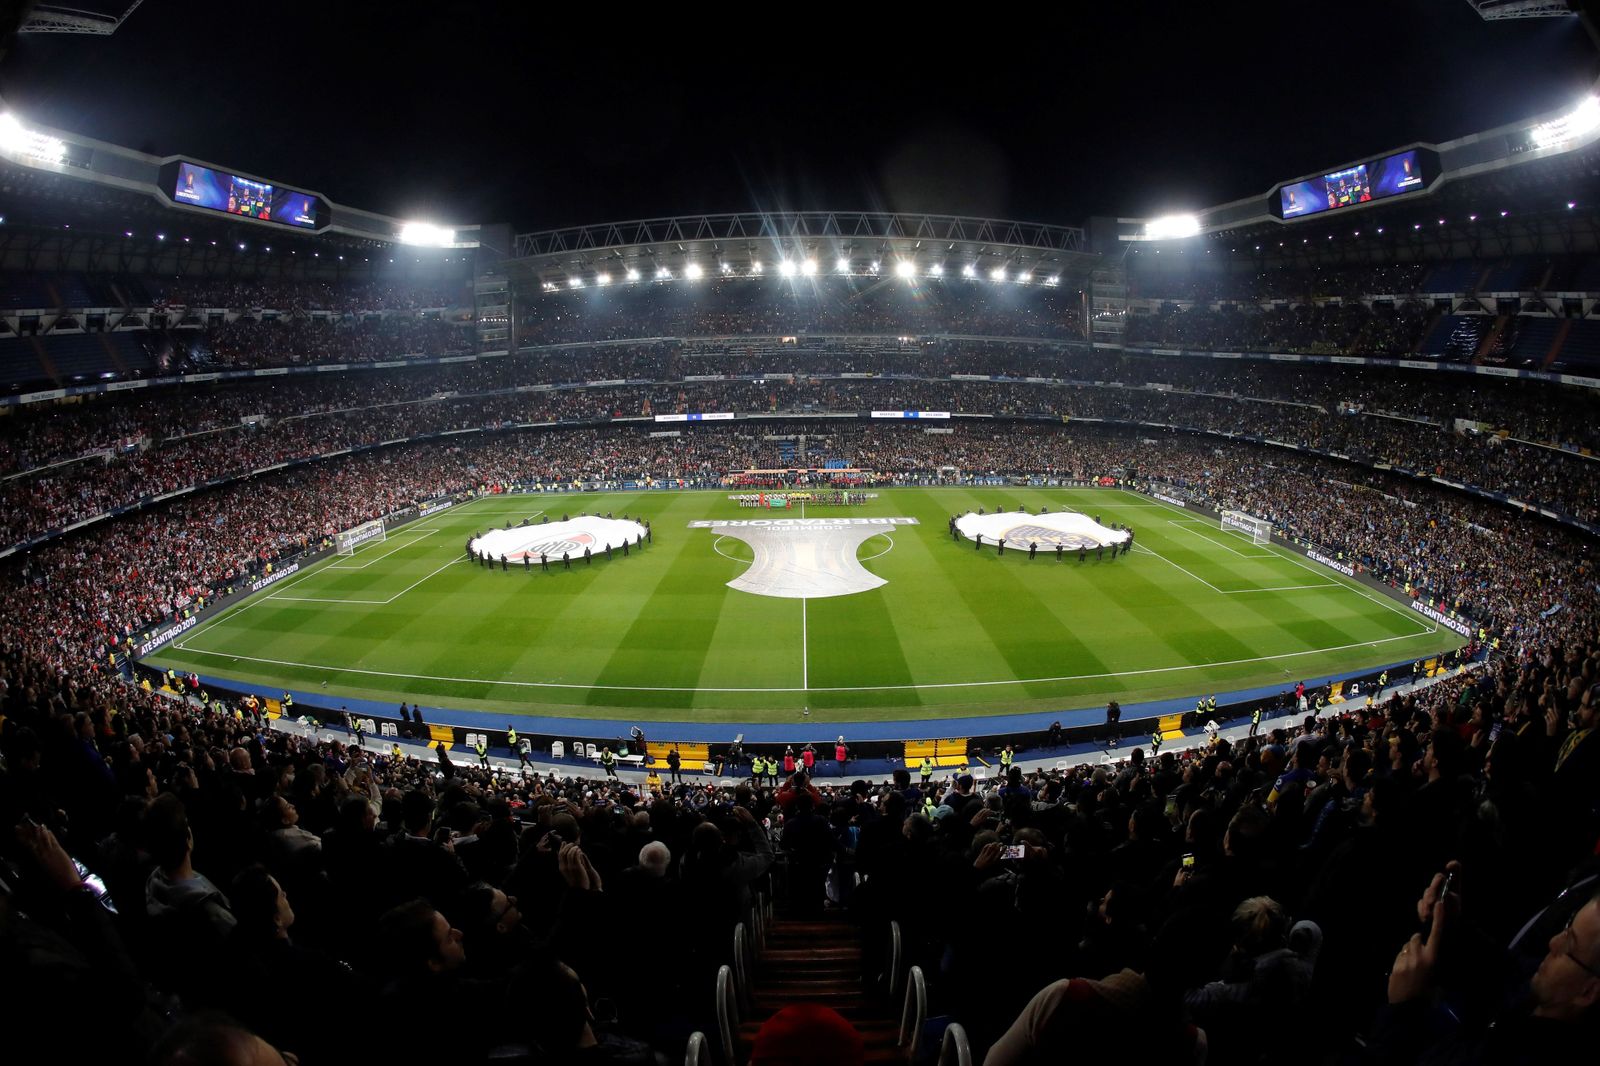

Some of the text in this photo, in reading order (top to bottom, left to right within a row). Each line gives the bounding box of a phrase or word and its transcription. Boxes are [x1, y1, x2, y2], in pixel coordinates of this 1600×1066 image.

[693, 518, 914, 528] LIBERTADORES
[1315, 554, 1341, 571] SANTIAGO
[1340, 564, 1354, 577] 2019
[261, 569, 288, 587] SANTIAGO
[1423, 606, 1456, 629] SANTIAGO
[152, 624, 183, 648] SANTIAGO
[181, 615, 197, 631] 2019
